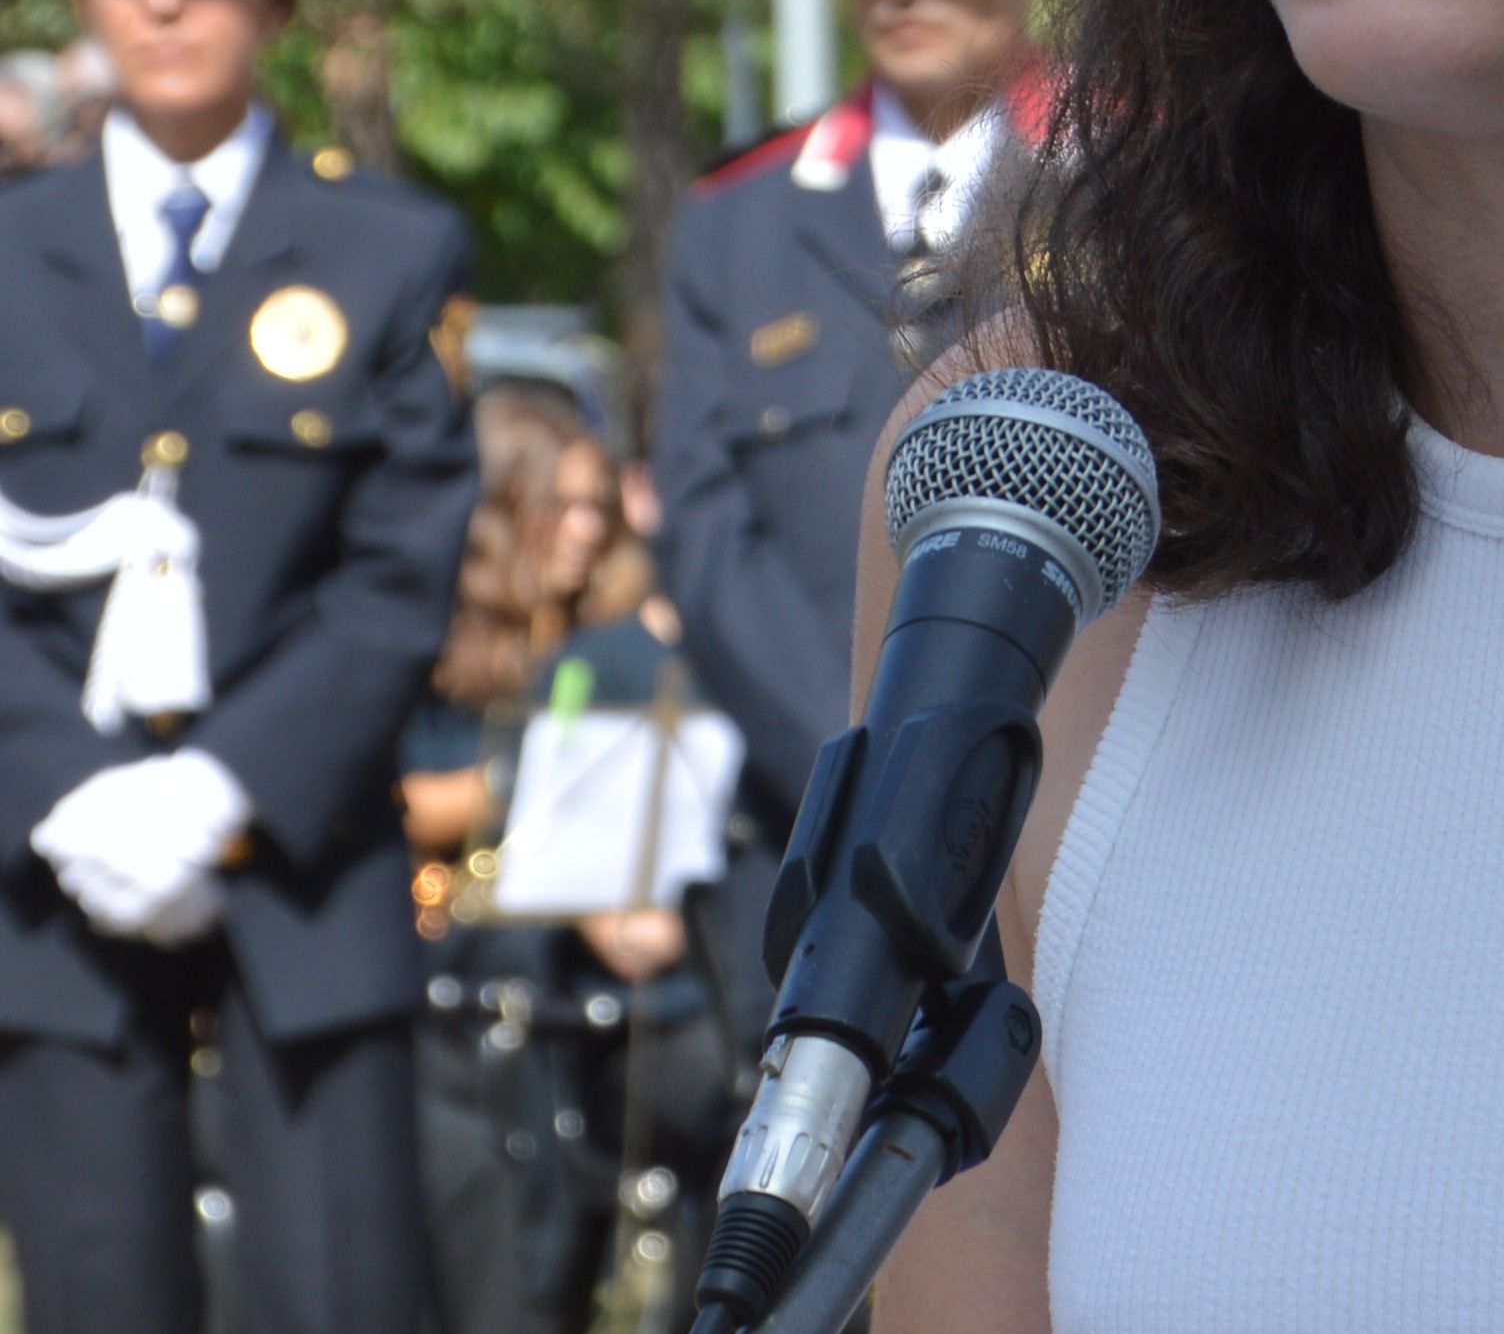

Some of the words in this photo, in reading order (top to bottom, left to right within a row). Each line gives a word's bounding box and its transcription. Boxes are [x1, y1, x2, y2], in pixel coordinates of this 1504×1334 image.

[910, 530, 963, 561] URE
[976, 532, 1029, 560] SM58
[1040, 559, 1080, 609] SHU
